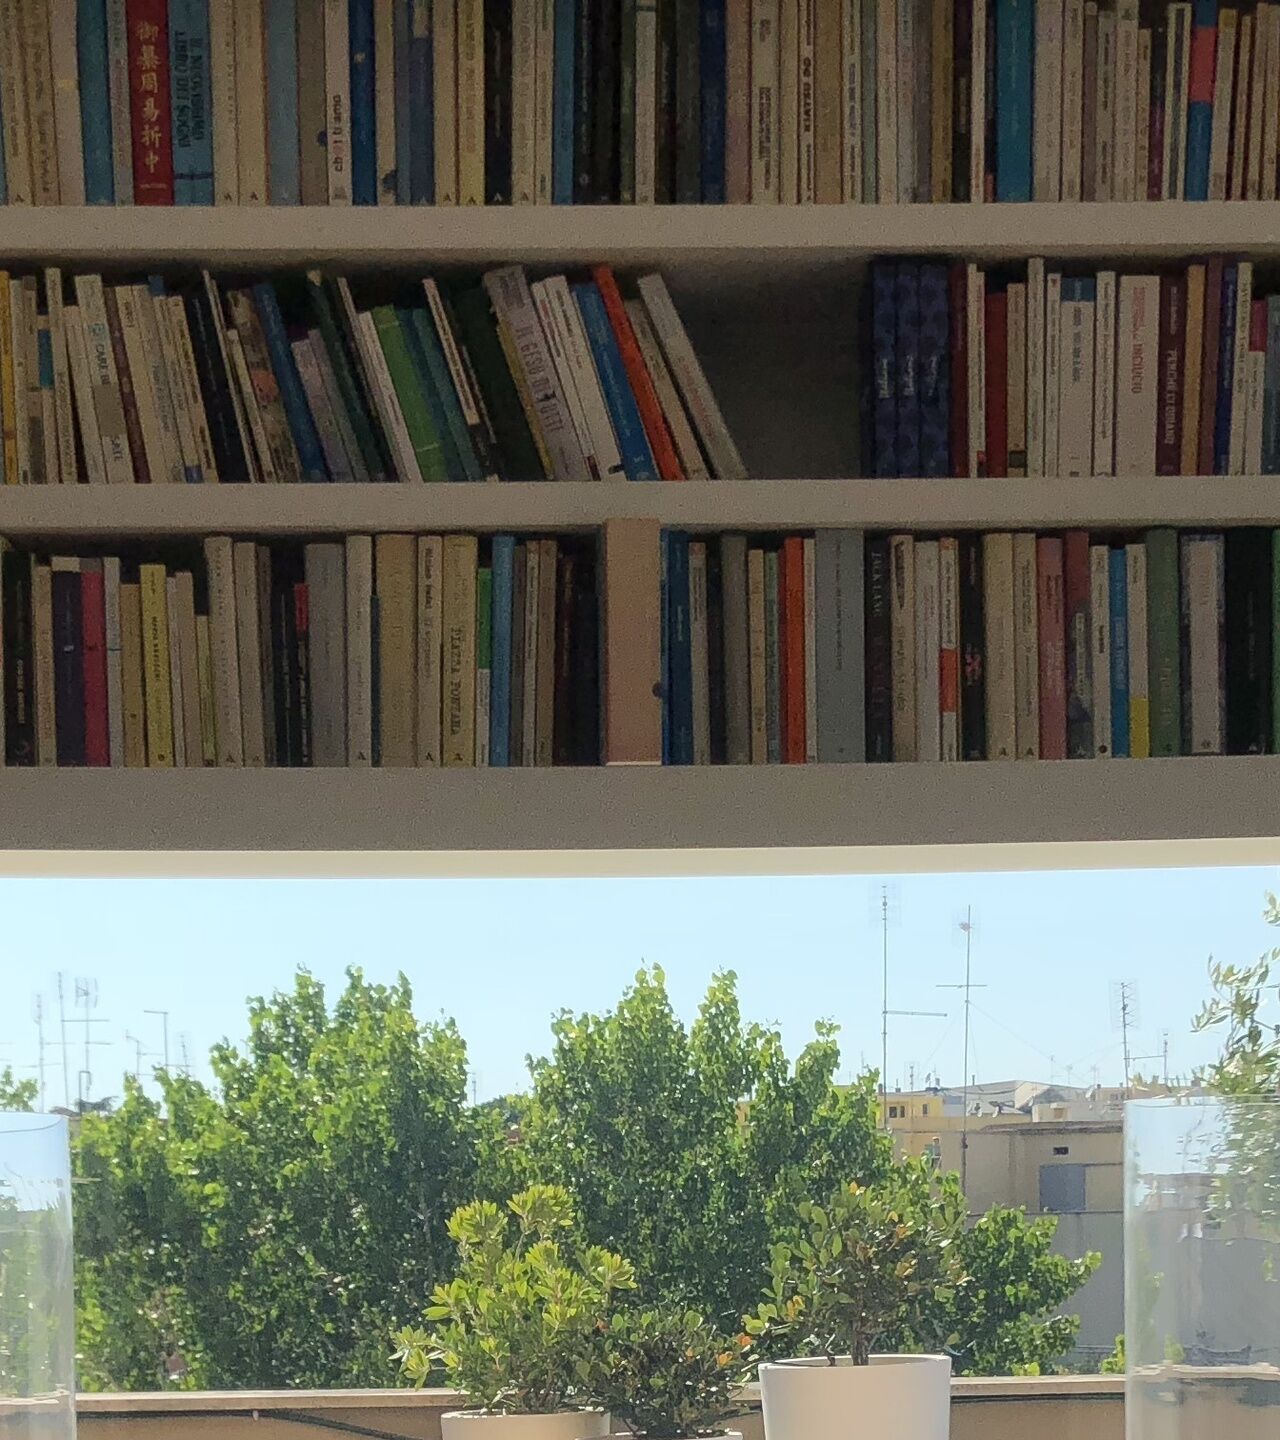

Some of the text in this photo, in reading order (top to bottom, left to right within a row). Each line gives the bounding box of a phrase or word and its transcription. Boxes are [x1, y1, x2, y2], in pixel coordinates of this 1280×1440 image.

[174, 30, 192, 148] LIBRO DEI SOGNI
[449, 626, 461, 735] PIAZZA FONTANA
